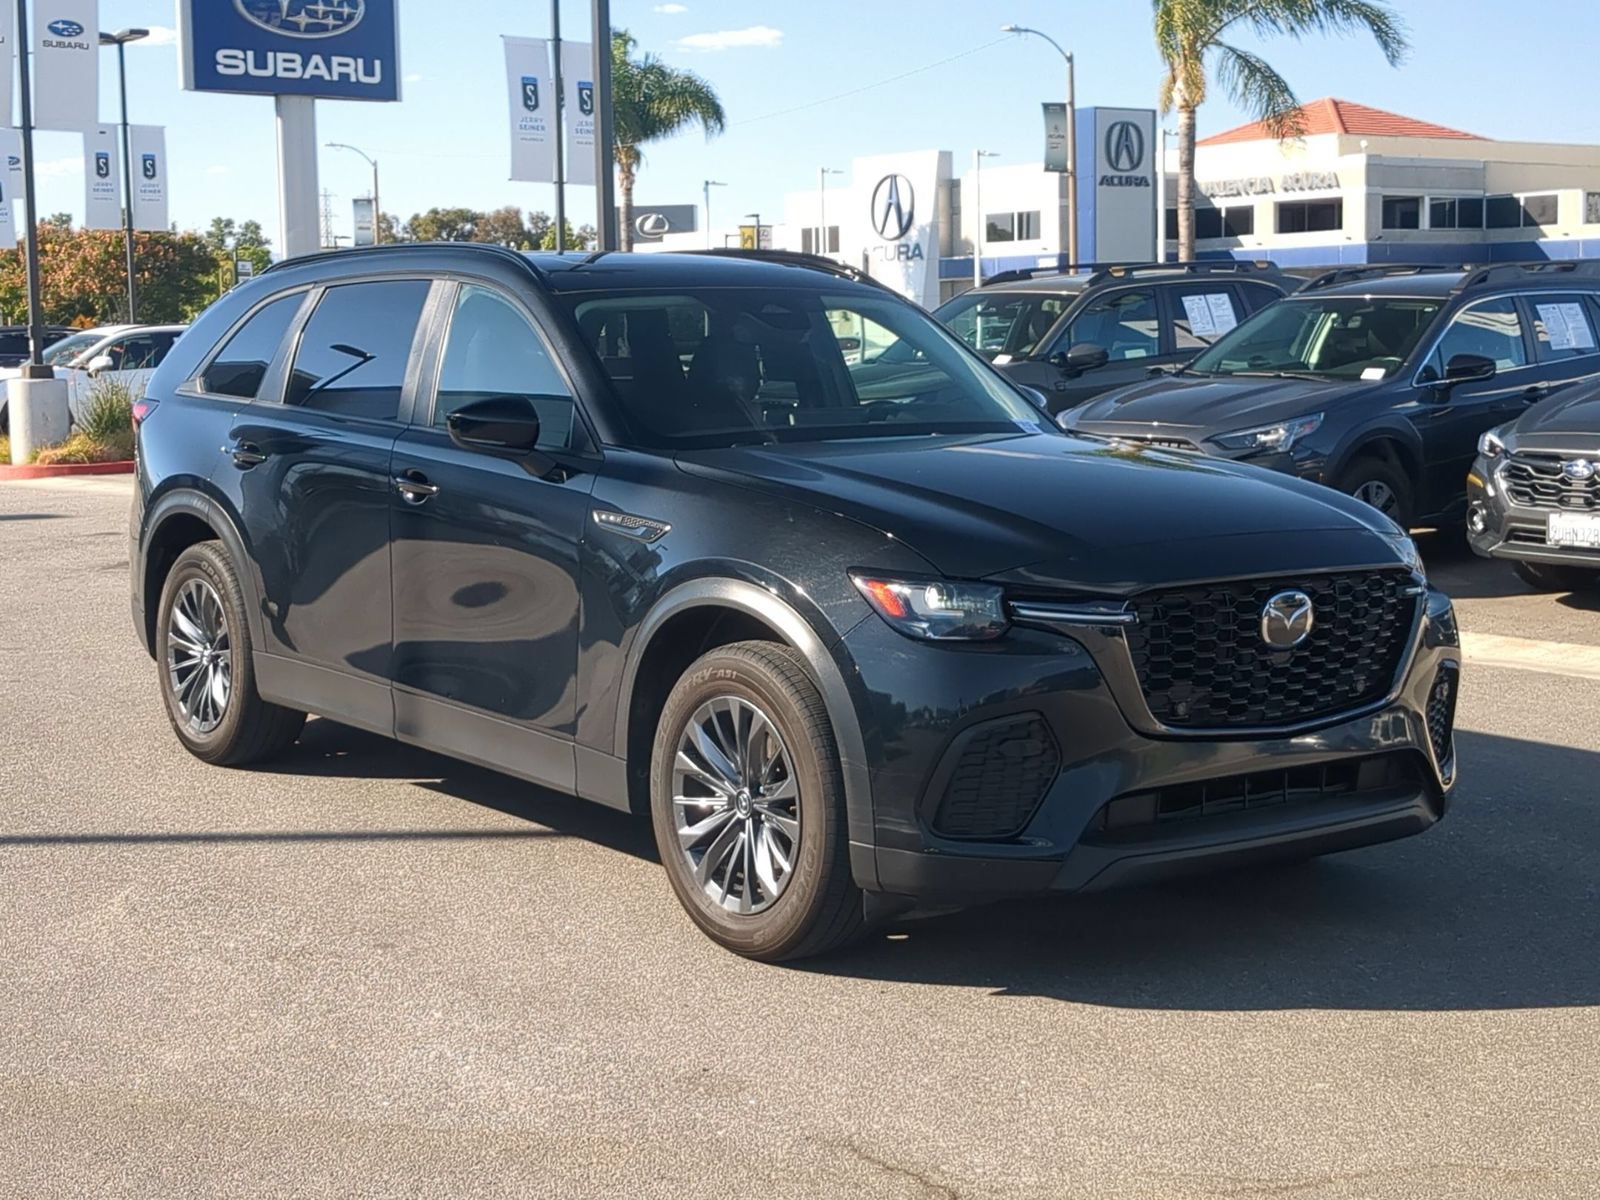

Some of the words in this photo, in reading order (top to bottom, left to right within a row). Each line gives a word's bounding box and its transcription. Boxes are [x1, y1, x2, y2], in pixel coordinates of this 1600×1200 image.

[42, 39, 90, 50] SUBARU
[215, 48, 382, 85] SUBARU
[1098, 174, 1151, 188] ACURA
